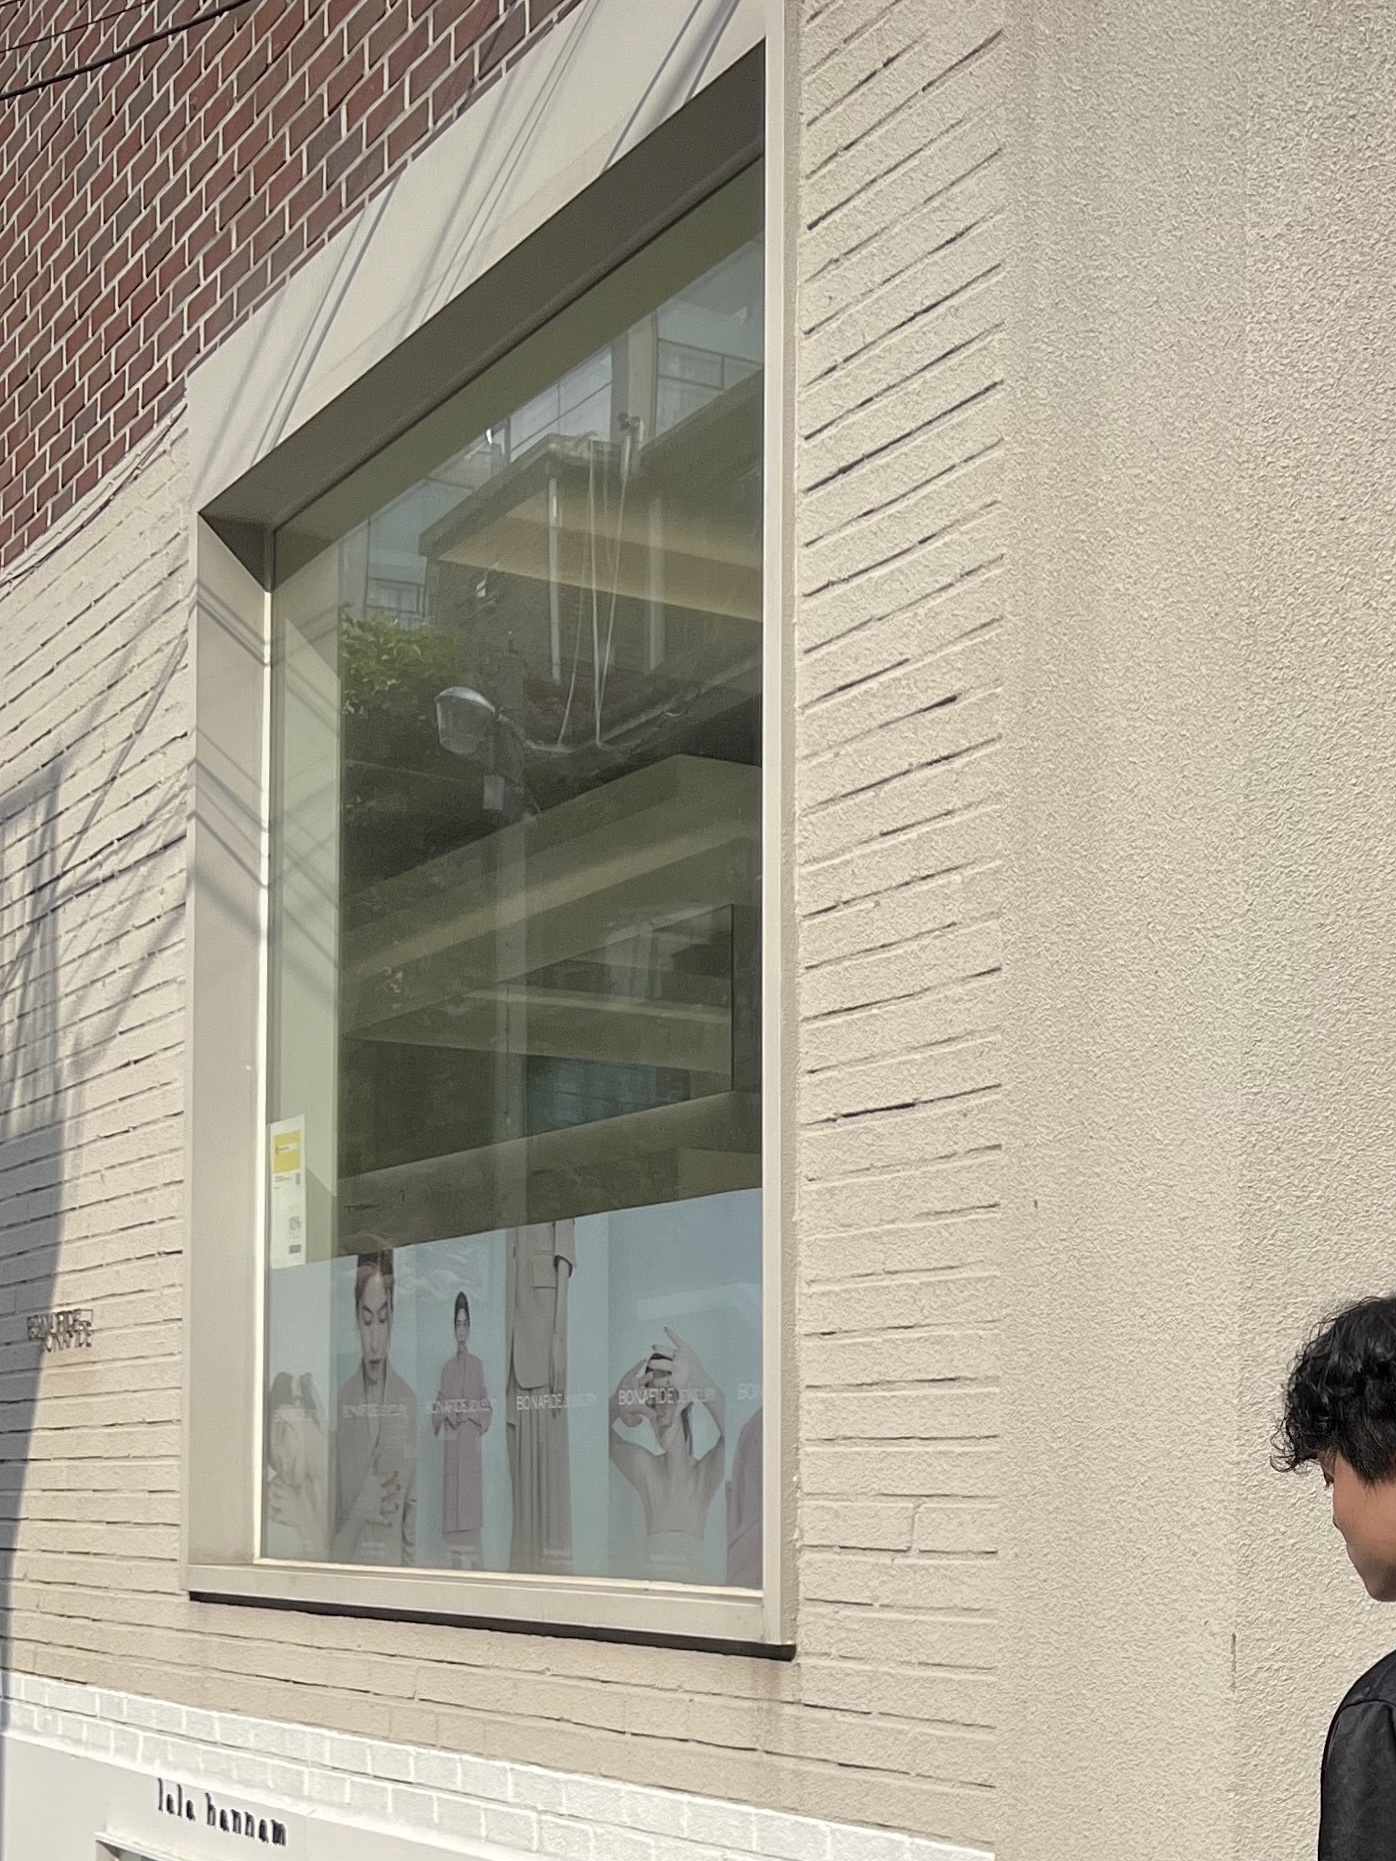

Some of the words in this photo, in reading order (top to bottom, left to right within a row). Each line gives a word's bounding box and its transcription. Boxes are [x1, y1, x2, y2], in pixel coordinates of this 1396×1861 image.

[516, 1393, 562, 1410] BONAFIDE
[618, 1387, 675, 1406] BONAFIDE
[157, 1777, 196, 1821] lala
[204, 1792, 287, 1847] hannam
